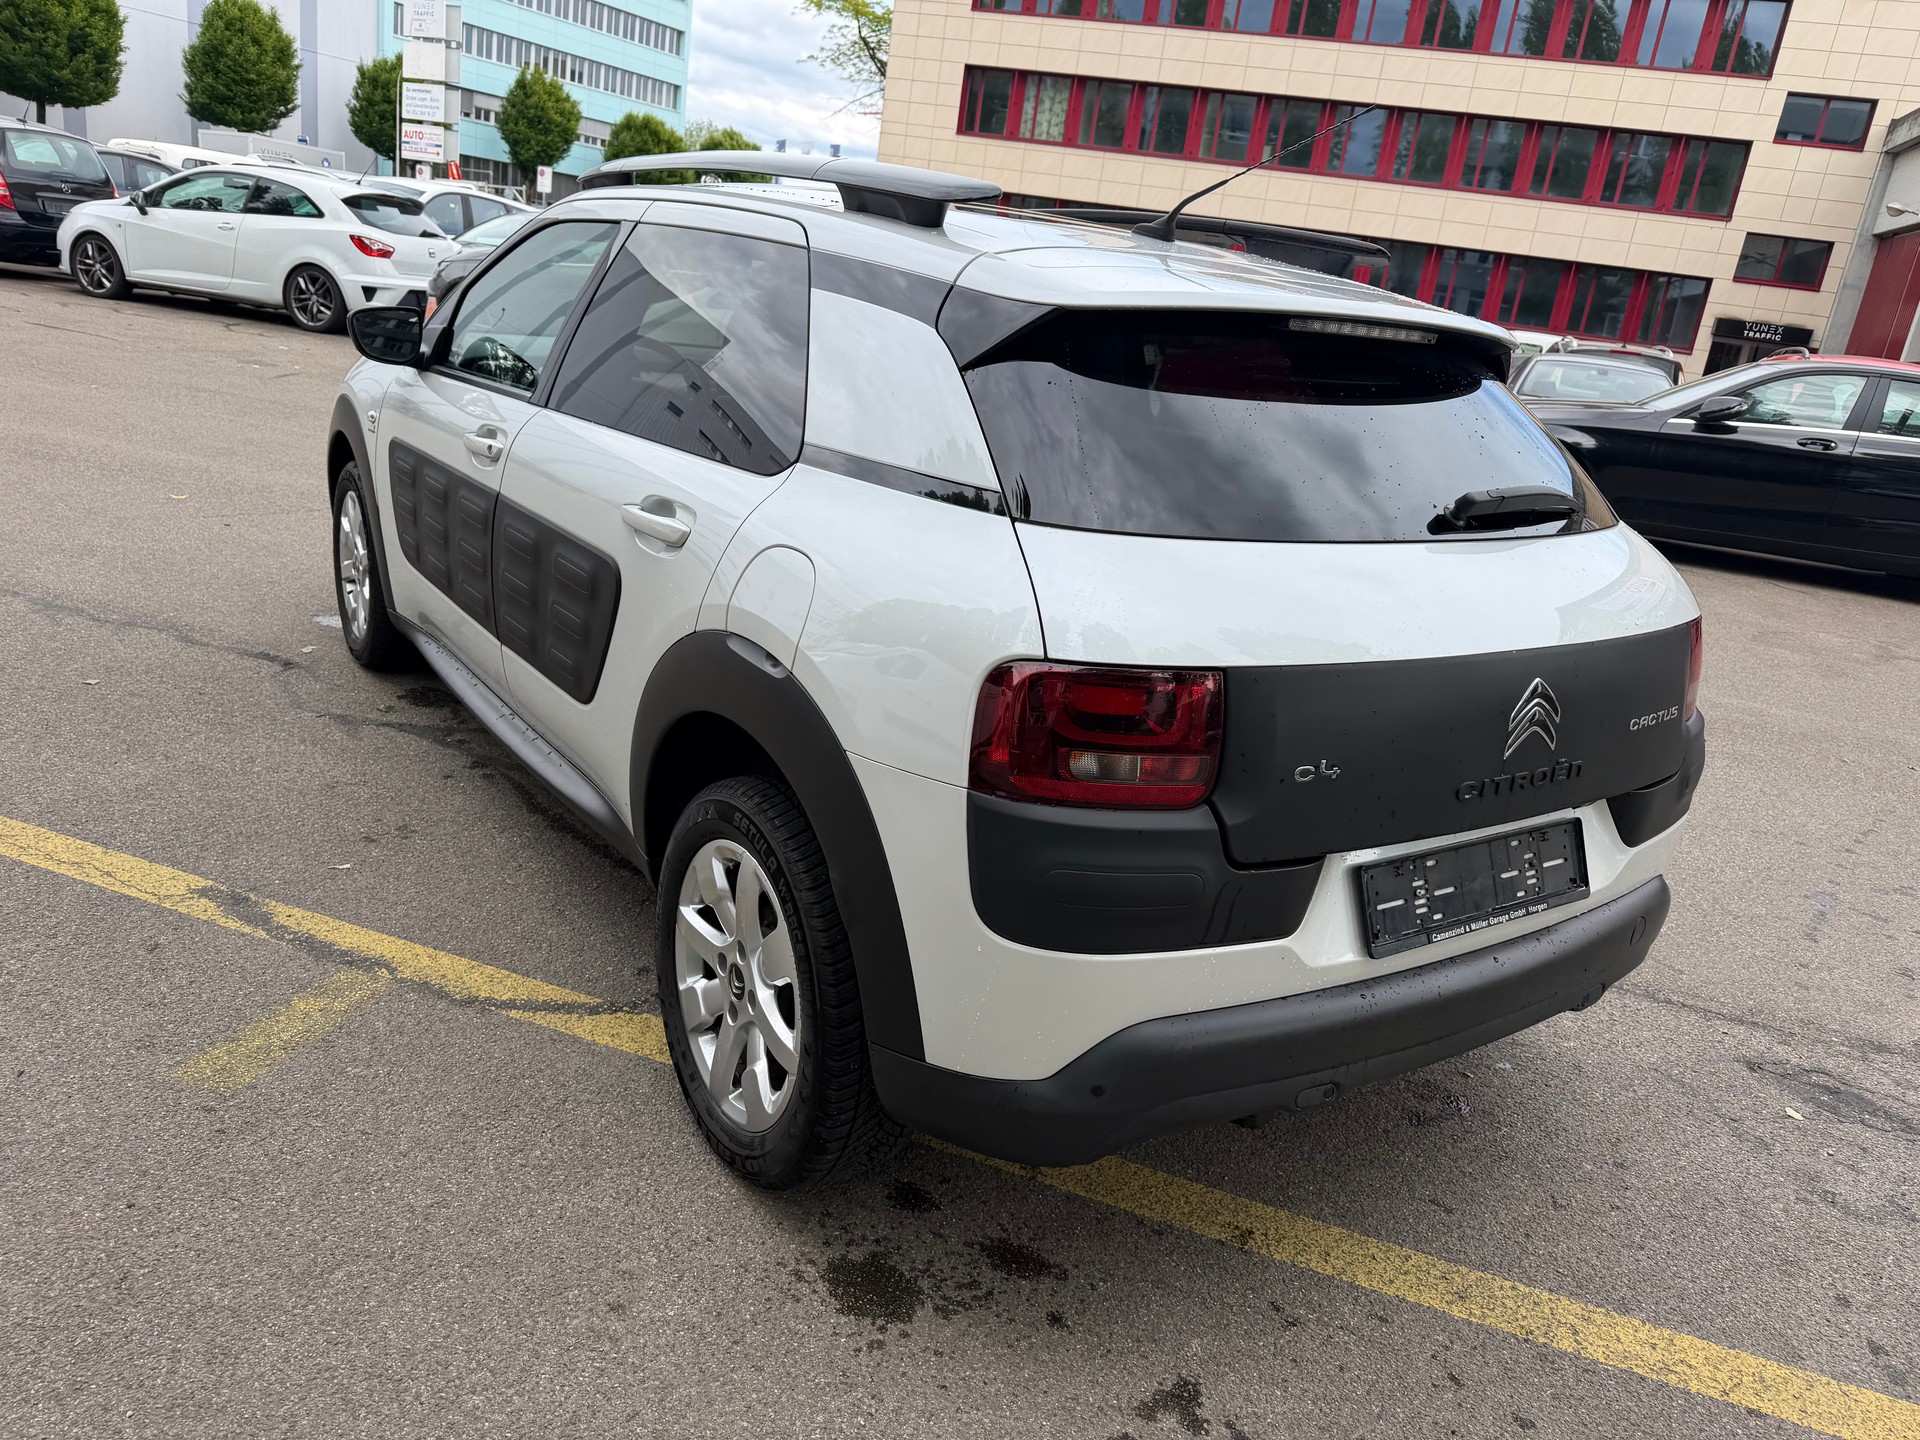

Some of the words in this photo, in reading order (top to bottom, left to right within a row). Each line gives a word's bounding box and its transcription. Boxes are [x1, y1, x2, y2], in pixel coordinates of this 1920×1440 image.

[404, 130, 424, 140] AUTO
[1743, 330, 1782, 340] TRAFFIC
[1745, 322, 1784, 334] YUNEX
[1629, 704, 1680, 731] CACTUS
[1294, 758, 1341, 783] C4
[1455, 757, 1585, 802] CITROËN
[732, 811, 778, 875] SETULA
[1432, 926, 1465, 942] Camenzind
[1471, 920, 1488, 931] Müller
[1489, 914, 1509, 925] Garage
[1510, 907, 1526, 919] GmbH
[1528, 902, 1548, 914] Horgen
